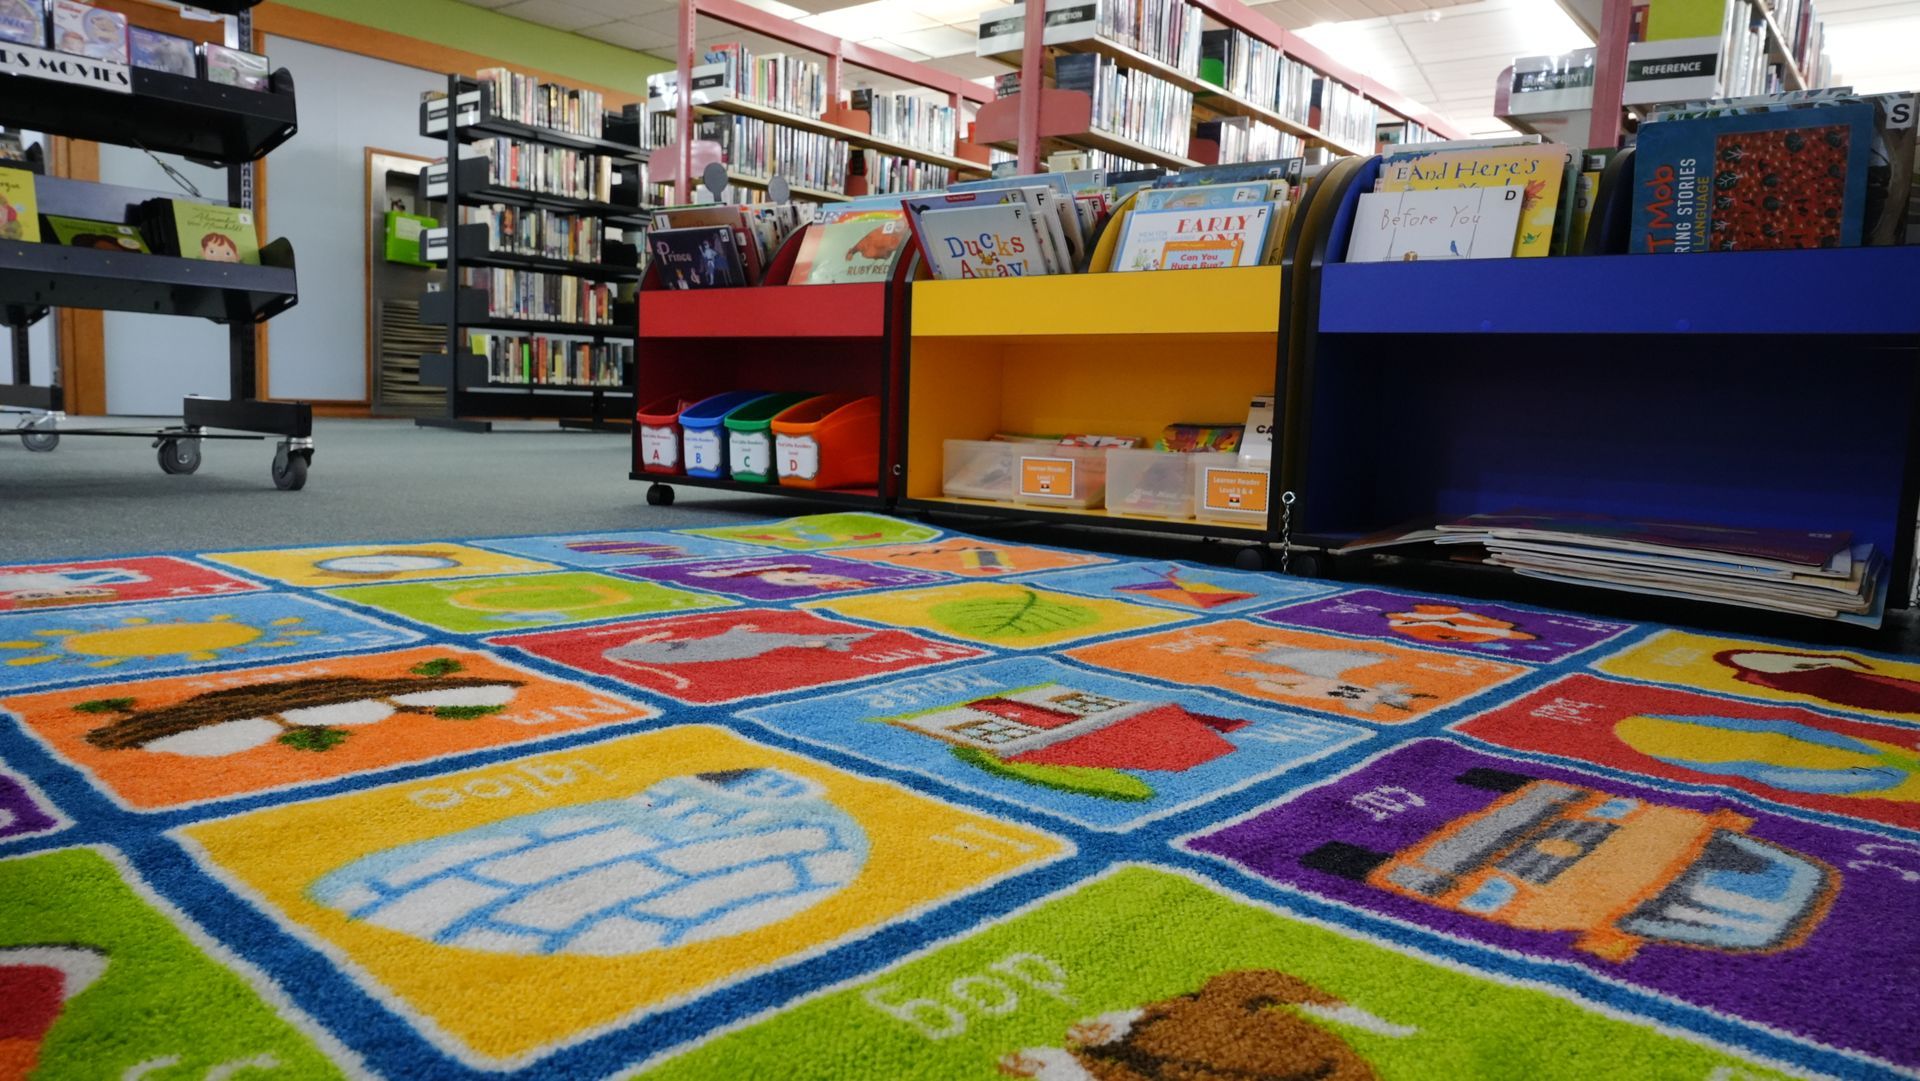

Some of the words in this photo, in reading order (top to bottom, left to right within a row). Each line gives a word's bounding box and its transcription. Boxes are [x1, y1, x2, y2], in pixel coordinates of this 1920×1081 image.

[1058, 11, 1083, 21] FICTION
[37, 57, 128, 86] MOVIES
[1641, 61, 1702, 75] REFERENCE
[1555, 73, 1584, 84] PRINT
[1890, 103, 1910, 124] S
[1290, 162, 1299, 171] F
[1410, 162, 1448, 181] And
[1455, 158, 1540, 179] Here's
[1093, 173, 1100, 183] F
[1396, 166, 1408, 179] E
[1676, 158, 1697, 216] STORIES
[1011, 193, 1017, 203] F
[1104, 193, 1110, 202] F
[1236, 191, 1245, 200] F
[1274, 189, 1282, 198] F
[1504, 190, 1517, 201] D
[1644, 164, 1675, 229] Mob
[1036, 193, 1045, 206] F
[1092, 200, 1099, 210] F
[1060, 202, 1066, 212] F
[1693, 176, 1710, 246] LANGUAGE
[1014, 209, 1022, 219] F
[1257, 208, 1266, 218] F
[1381, 207, 1438, 231] Before
[1451, 205, 1482, 228] You
[886, 223, 893, 231] G
[1176, 215, 1252, 234] EARLY
[1674, 222, 1692, 253] RING
[944, 232, 1025, 258] Ducks
[656, 241, 693, 266] Prince
[1180, 253, 1198, 261] Can
[1201, 253, 1219, 261] You
[847, 265, 872, 276] RUBY
[960, 259, 1029, 279] Away!
[652, 449, 660, 460] A
[695, 453, 702, 464] B
[743, 455, 751, 468] C
[789, 459, 798, 471] D
[1213, 476, 1237, 484] Learner
[1237, 478, 1260, 486] Reader
[408, 758, 622, 810] igloo
[862, 952, 1080, 1041] dog
